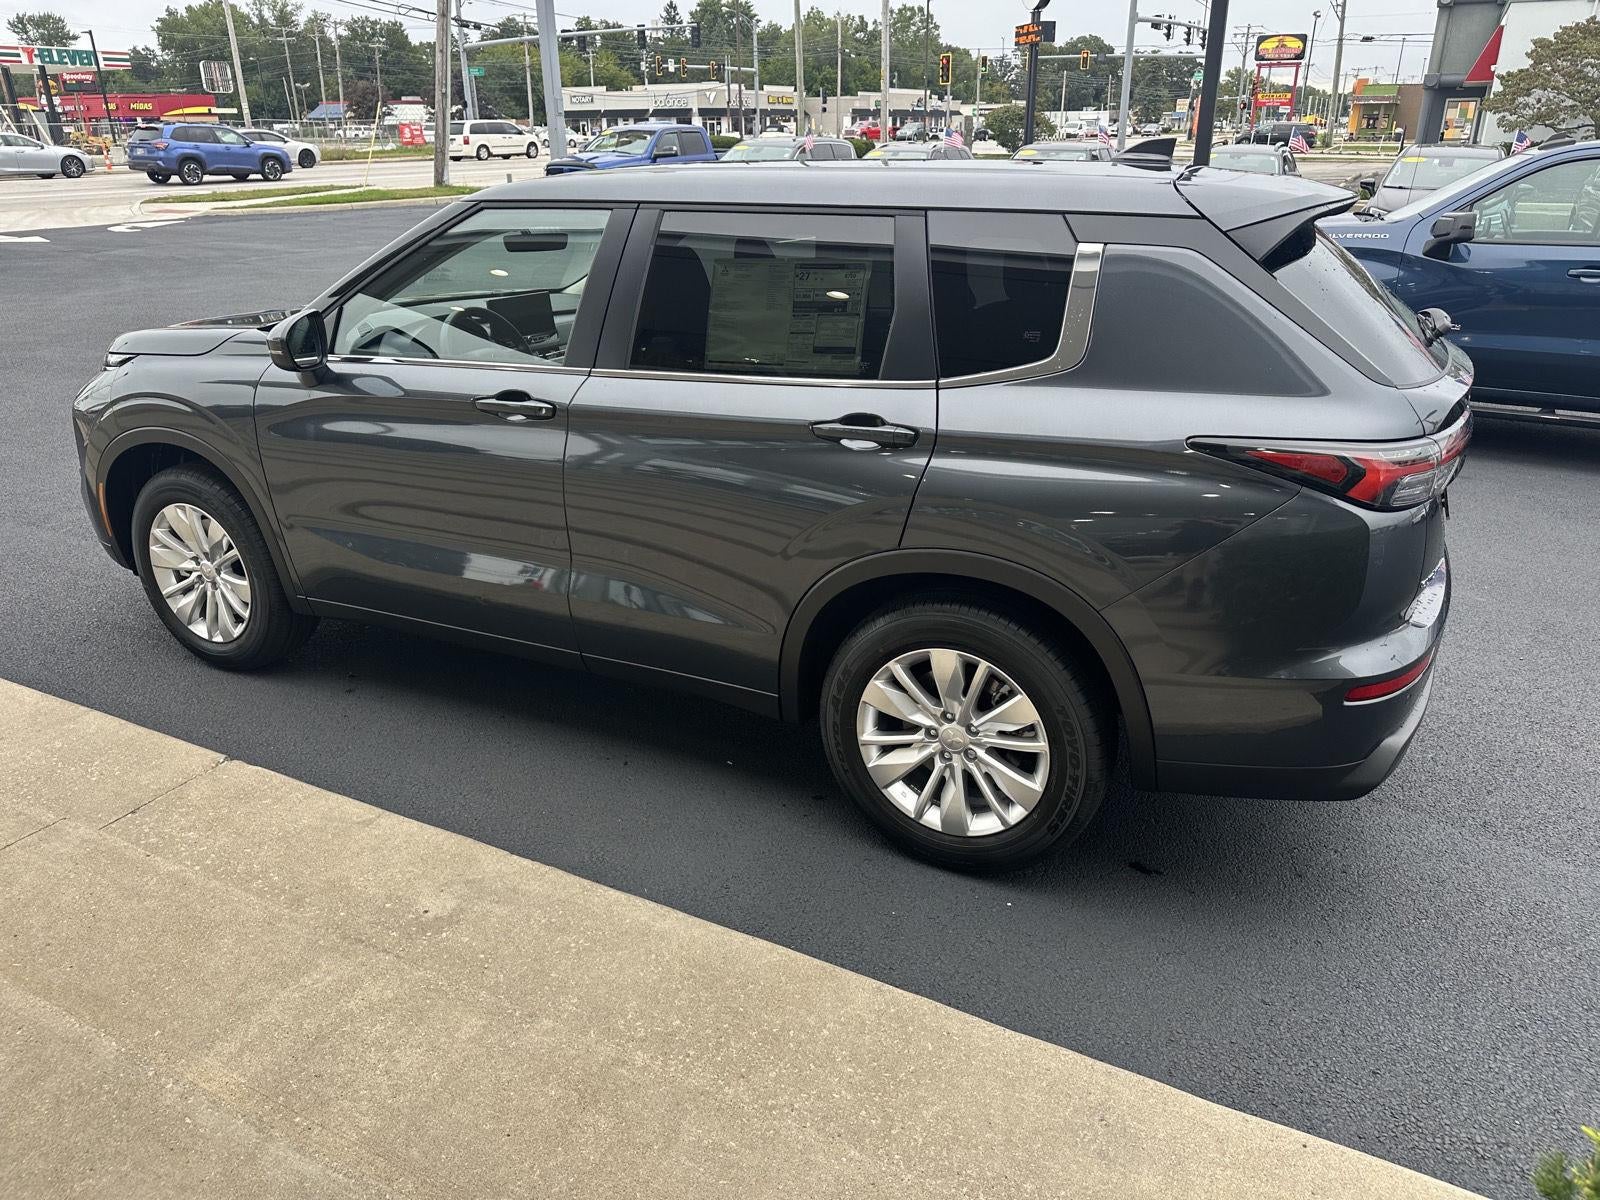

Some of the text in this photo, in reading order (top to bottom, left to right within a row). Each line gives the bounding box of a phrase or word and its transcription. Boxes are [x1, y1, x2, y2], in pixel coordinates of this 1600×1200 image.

[62, 73, 93, 81] Speedway
[571, 95, 593, 103] NOTARY
[652, 93, 688, 107] balance
[130, 101, 153, 110] MIDAS
[799, 271, 811, 280] 27
